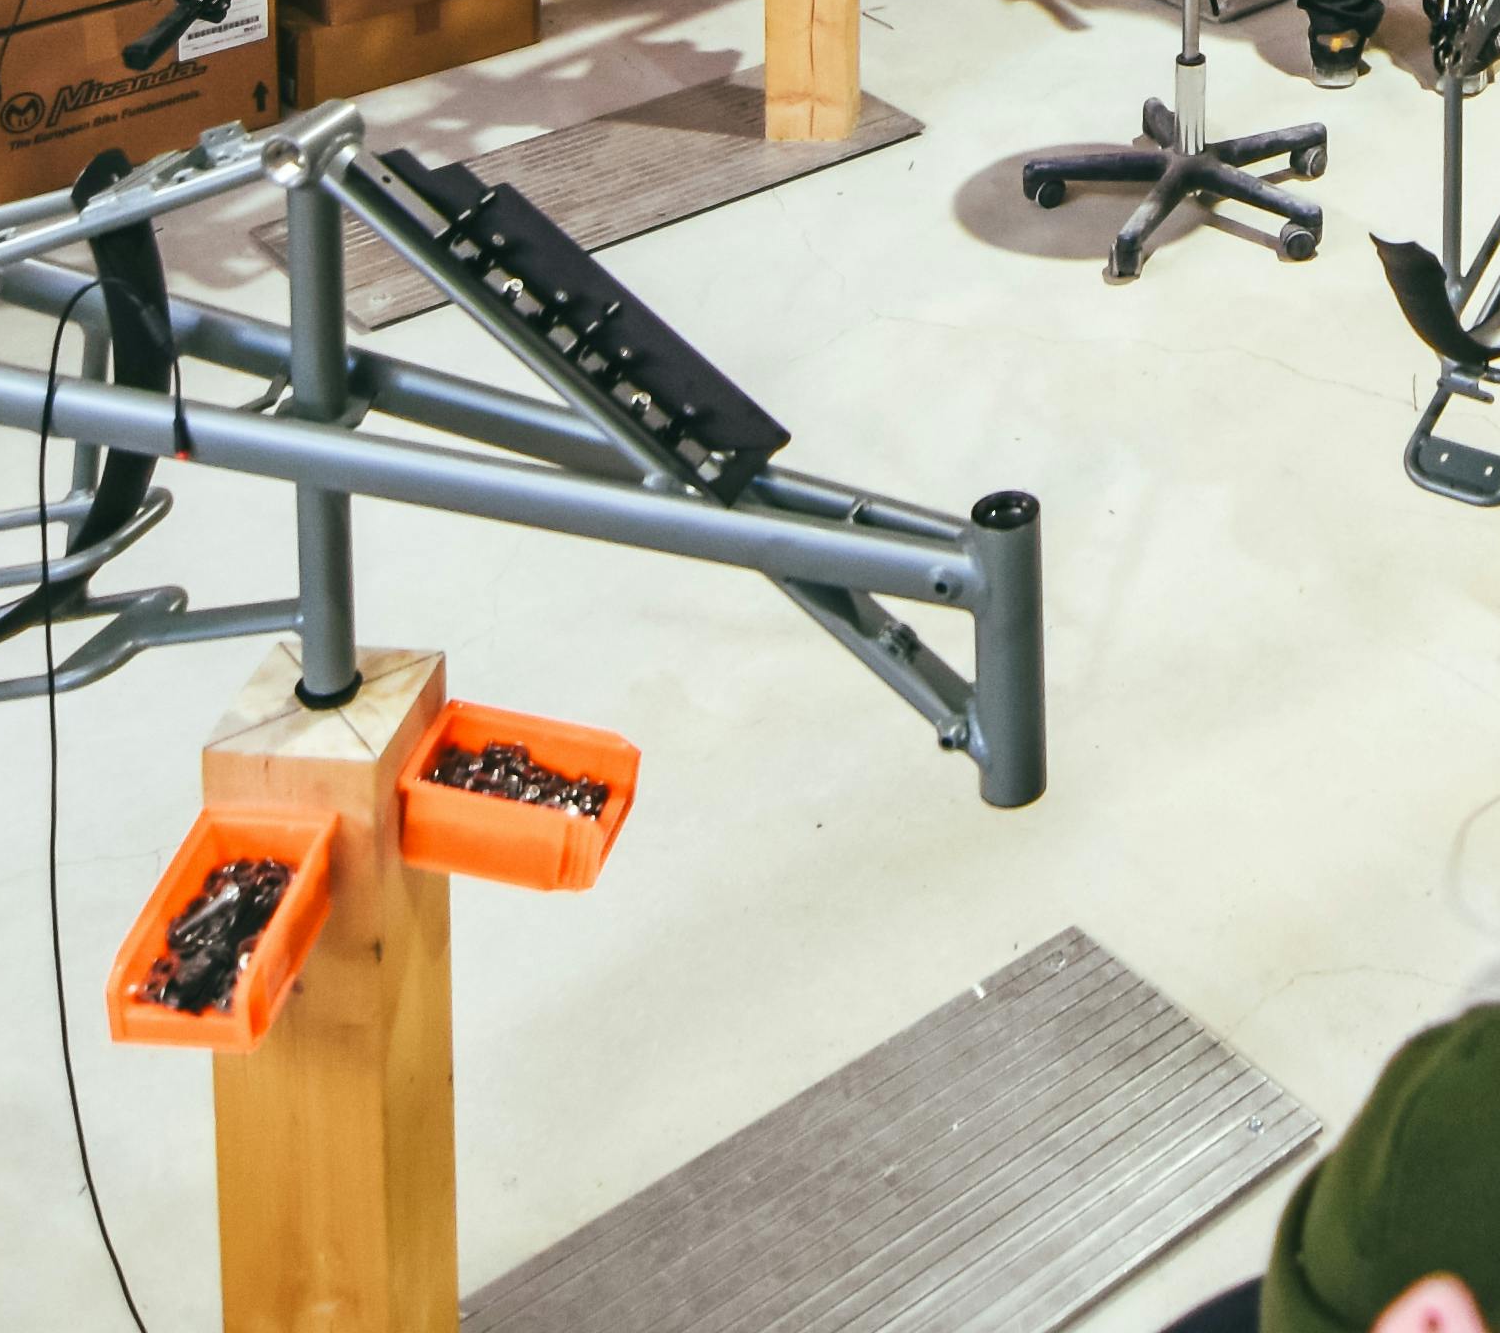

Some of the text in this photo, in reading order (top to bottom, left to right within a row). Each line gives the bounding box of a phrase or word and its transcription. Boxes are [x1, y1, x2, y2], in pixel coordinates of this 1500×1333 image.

[46, 60, 208, 129] Miranda
[9, 137, 33, 152] The
[34, 121, 92, 145] European
[93, 113, 118, 127] Bike
